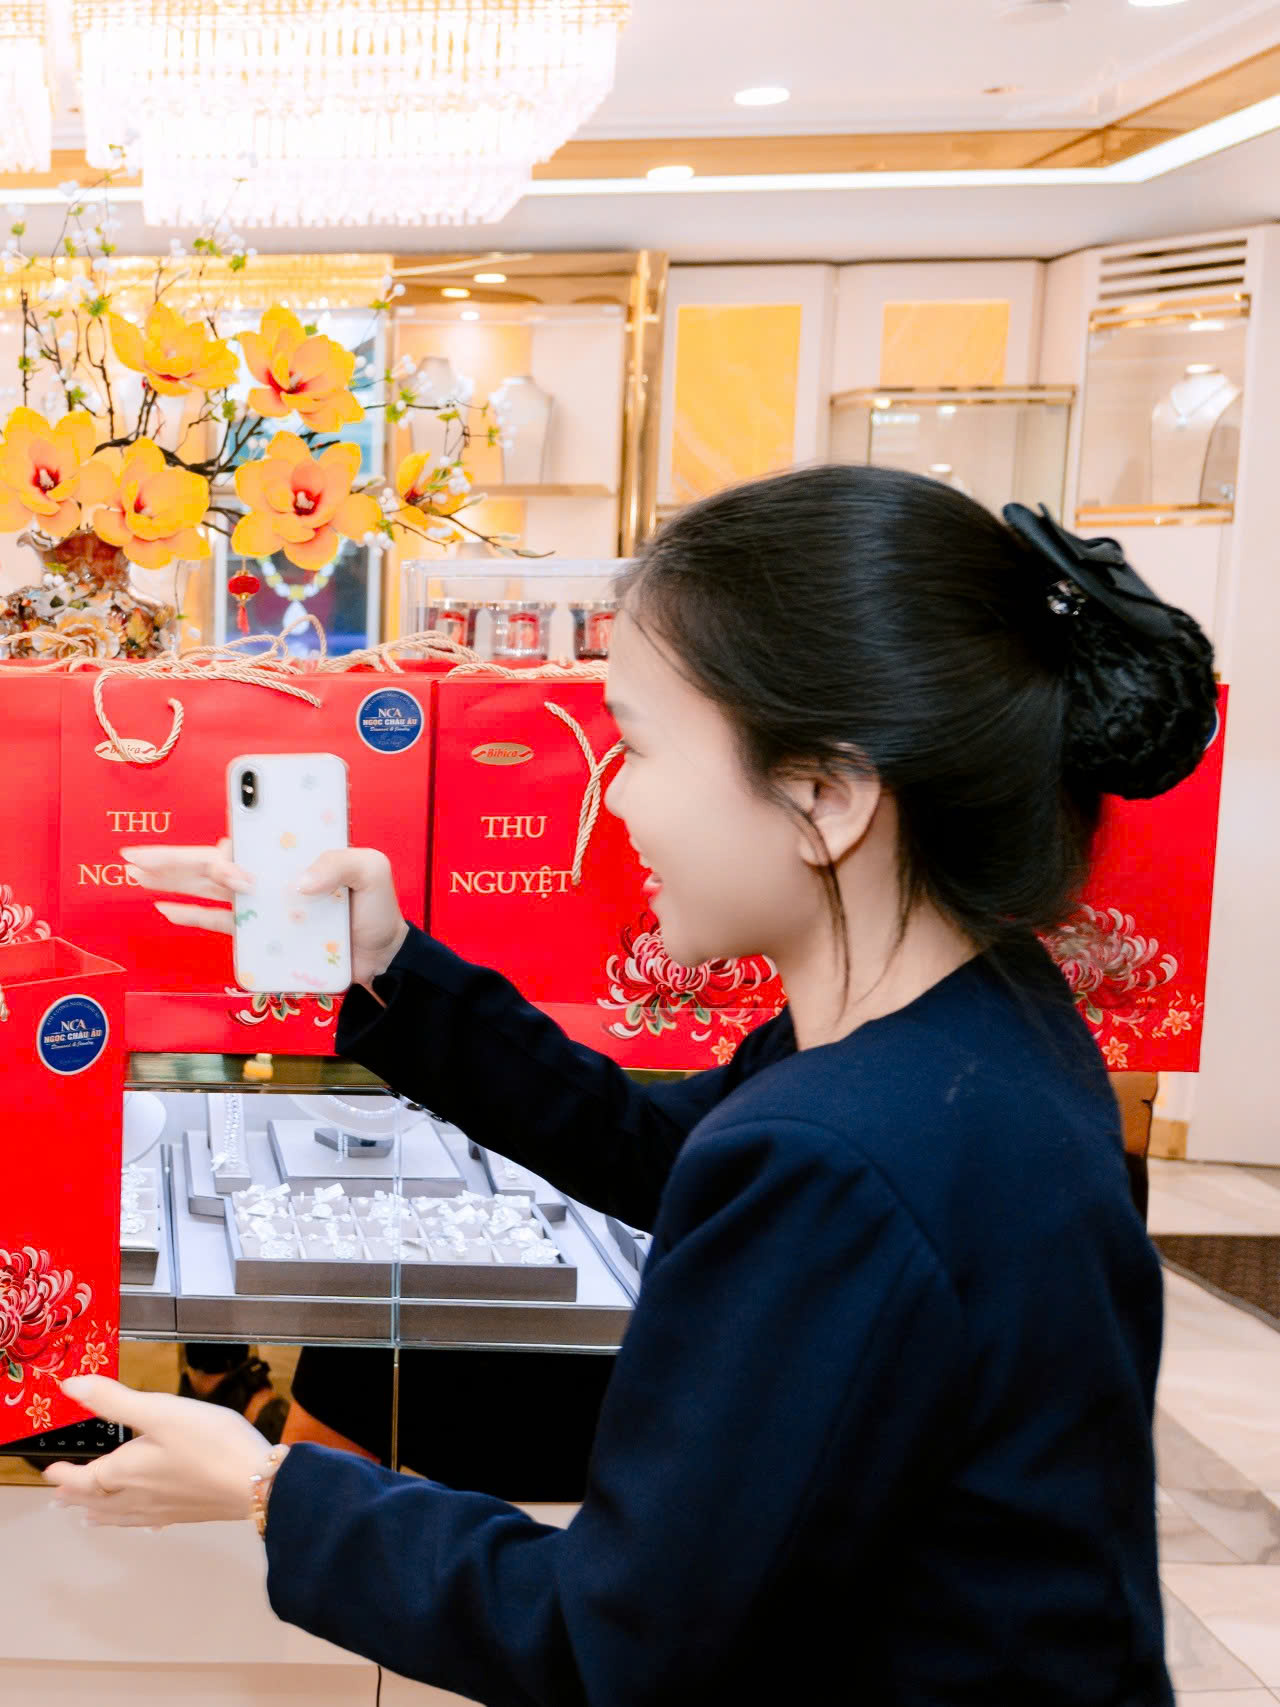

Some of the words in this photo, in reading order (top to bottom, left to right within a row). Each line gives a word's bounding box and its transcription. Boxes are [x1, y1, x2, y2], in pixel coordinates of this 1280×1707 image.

[378, 707, 402, 718] NCA
[107, 811, 172, 833] THU
[481, 816, 548, 838] THU
[450, 865, 573, 899] NGUYỆT
[60, 1018, 88, 1032] NCA
